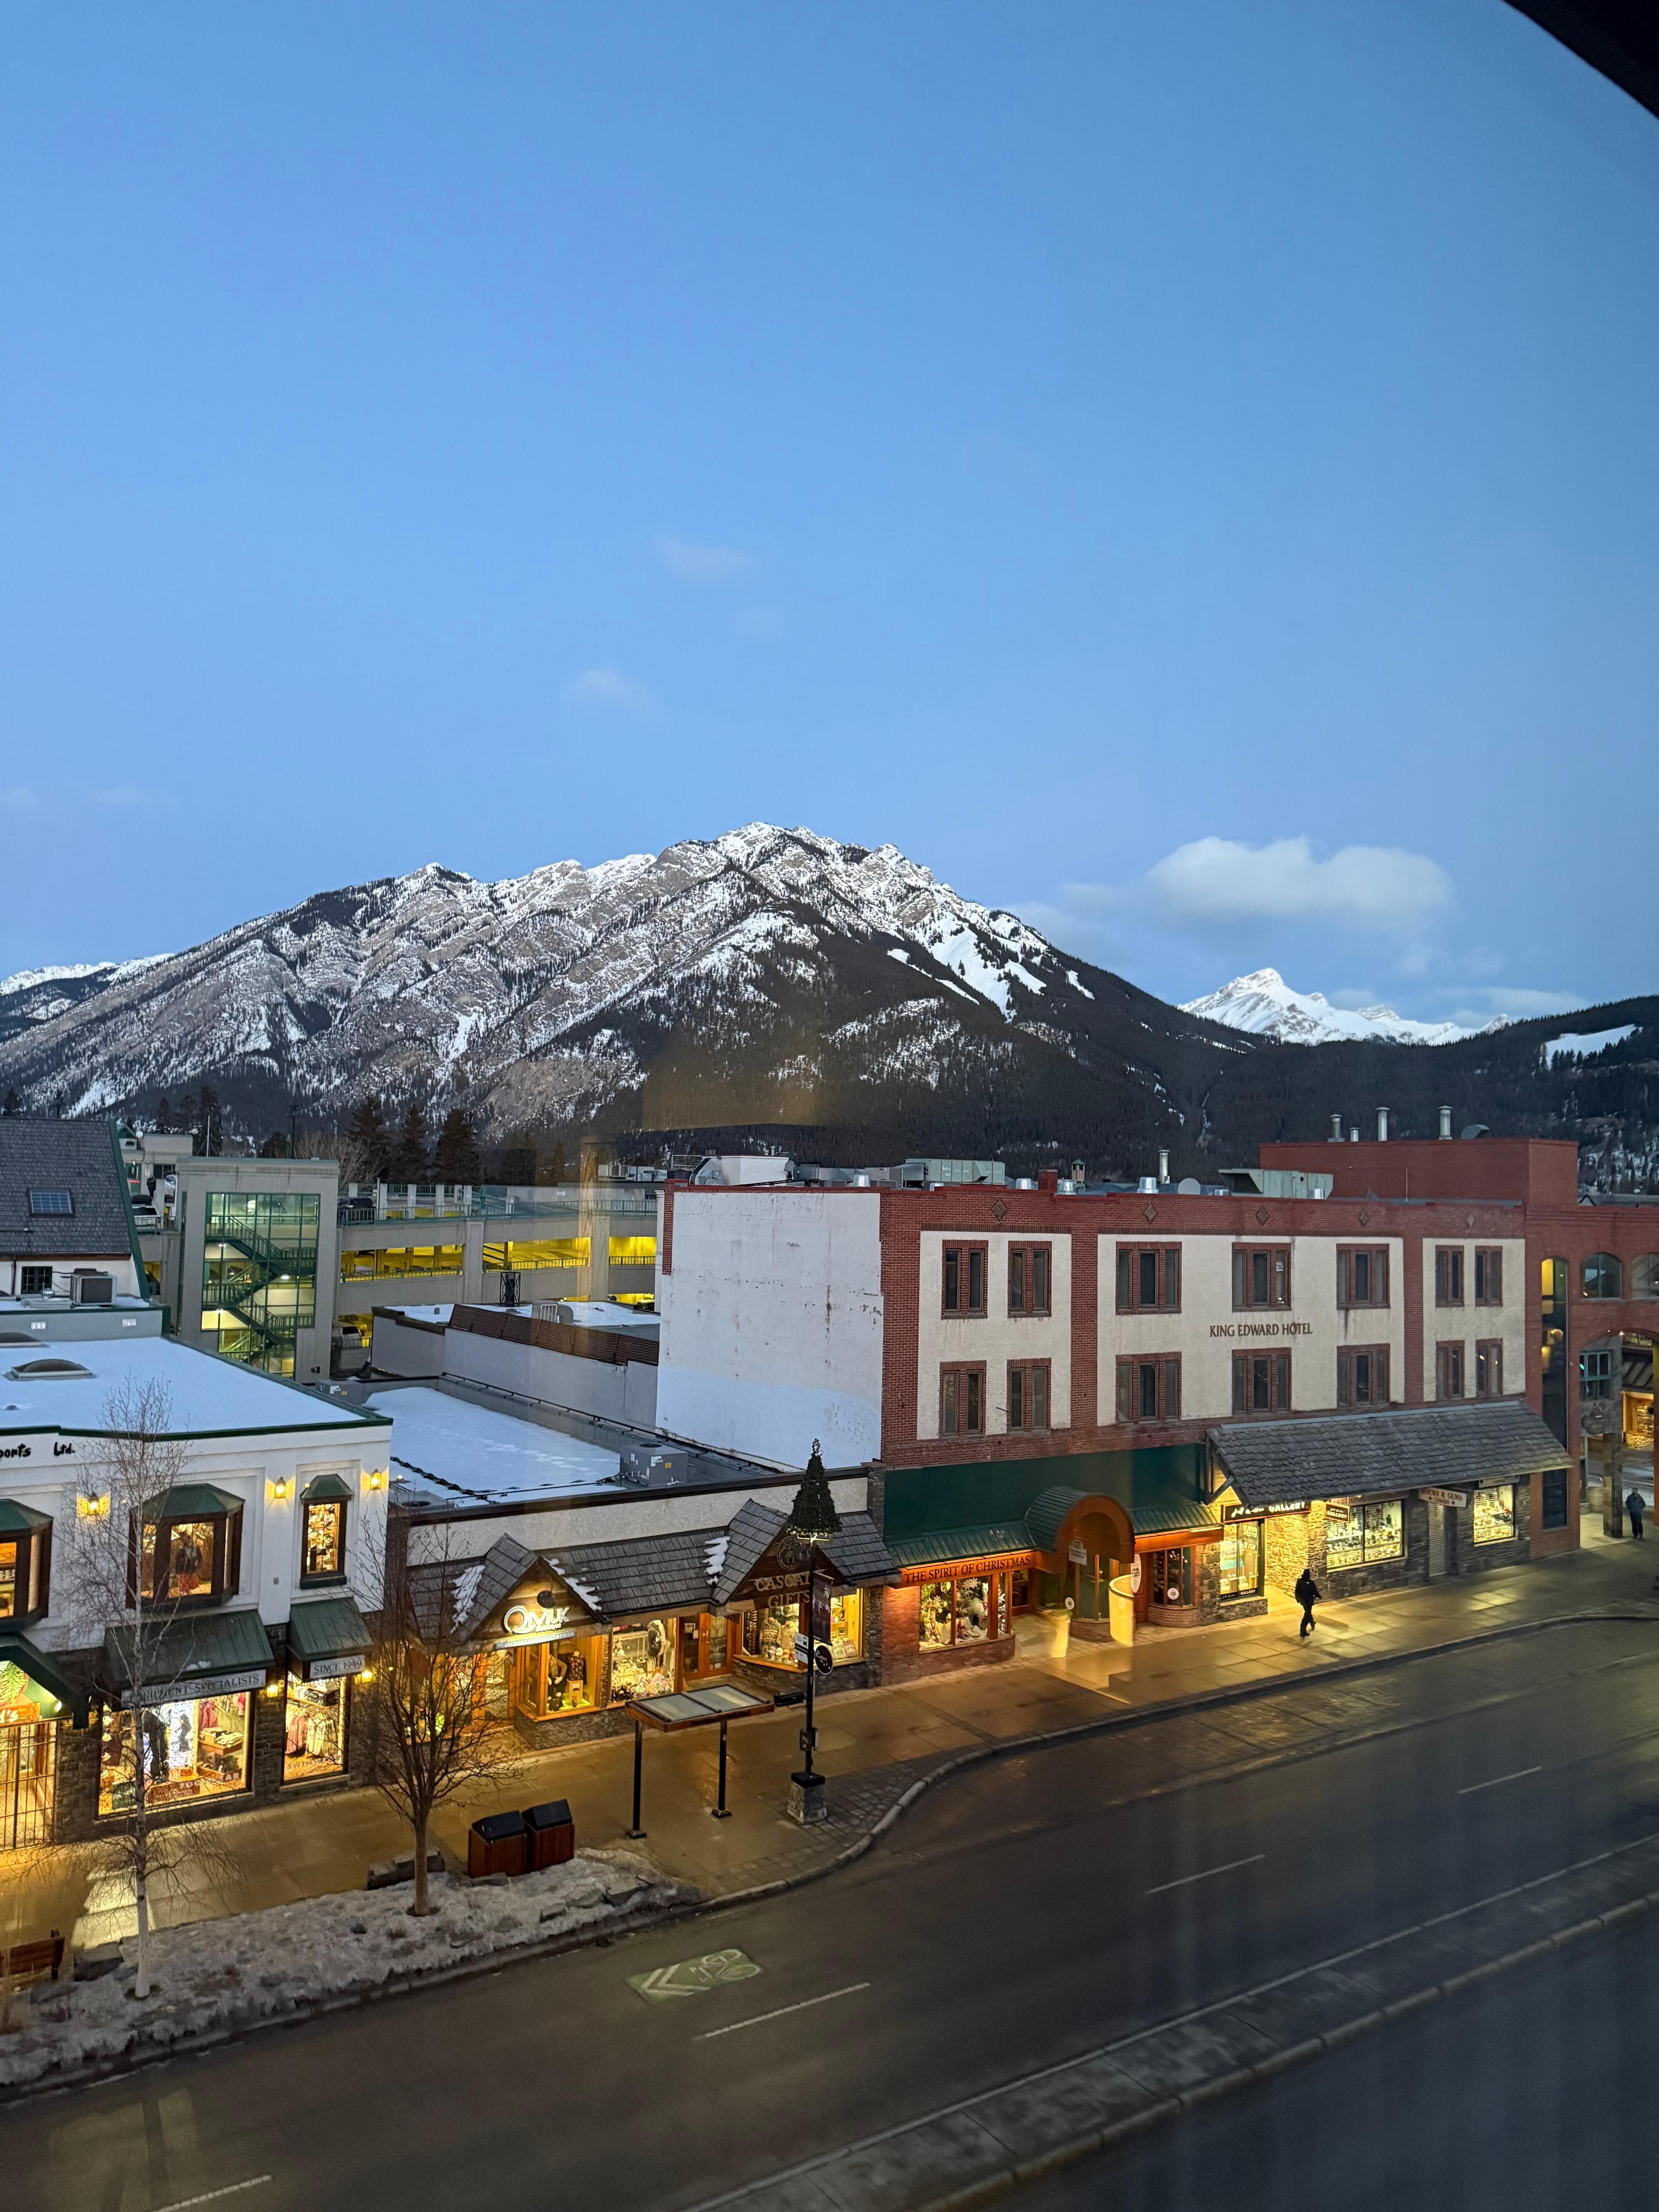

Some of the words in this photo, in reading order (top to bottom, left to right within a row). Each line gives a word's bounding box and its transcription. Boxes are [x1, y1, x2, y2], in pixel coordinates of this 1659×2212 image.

[1209, 1325, 1235, 1337] KING
[1238, 1324, 1279, 1336] EDWARD
[1282, 1322, 1313, 1335] HOTEL
[1421, 1488, 1439, 1497] ROCKS
[1448, 1492, 1463, 1501] GEMS
[904, 1571, 926, 1583] THE
[928, 1566, 959, 1580] SPIRIT
[961, 1563, 975, 1575] OF
[975, 1556, 1030, 1573] CHRISTMAS
[754, 1571, 810, 1592] CASCA
[768, 1590, 810, 1608] GIFTS
[314, 1663, 341, 1673] SINCE
[343, 1659, 362, 1670] 1949
